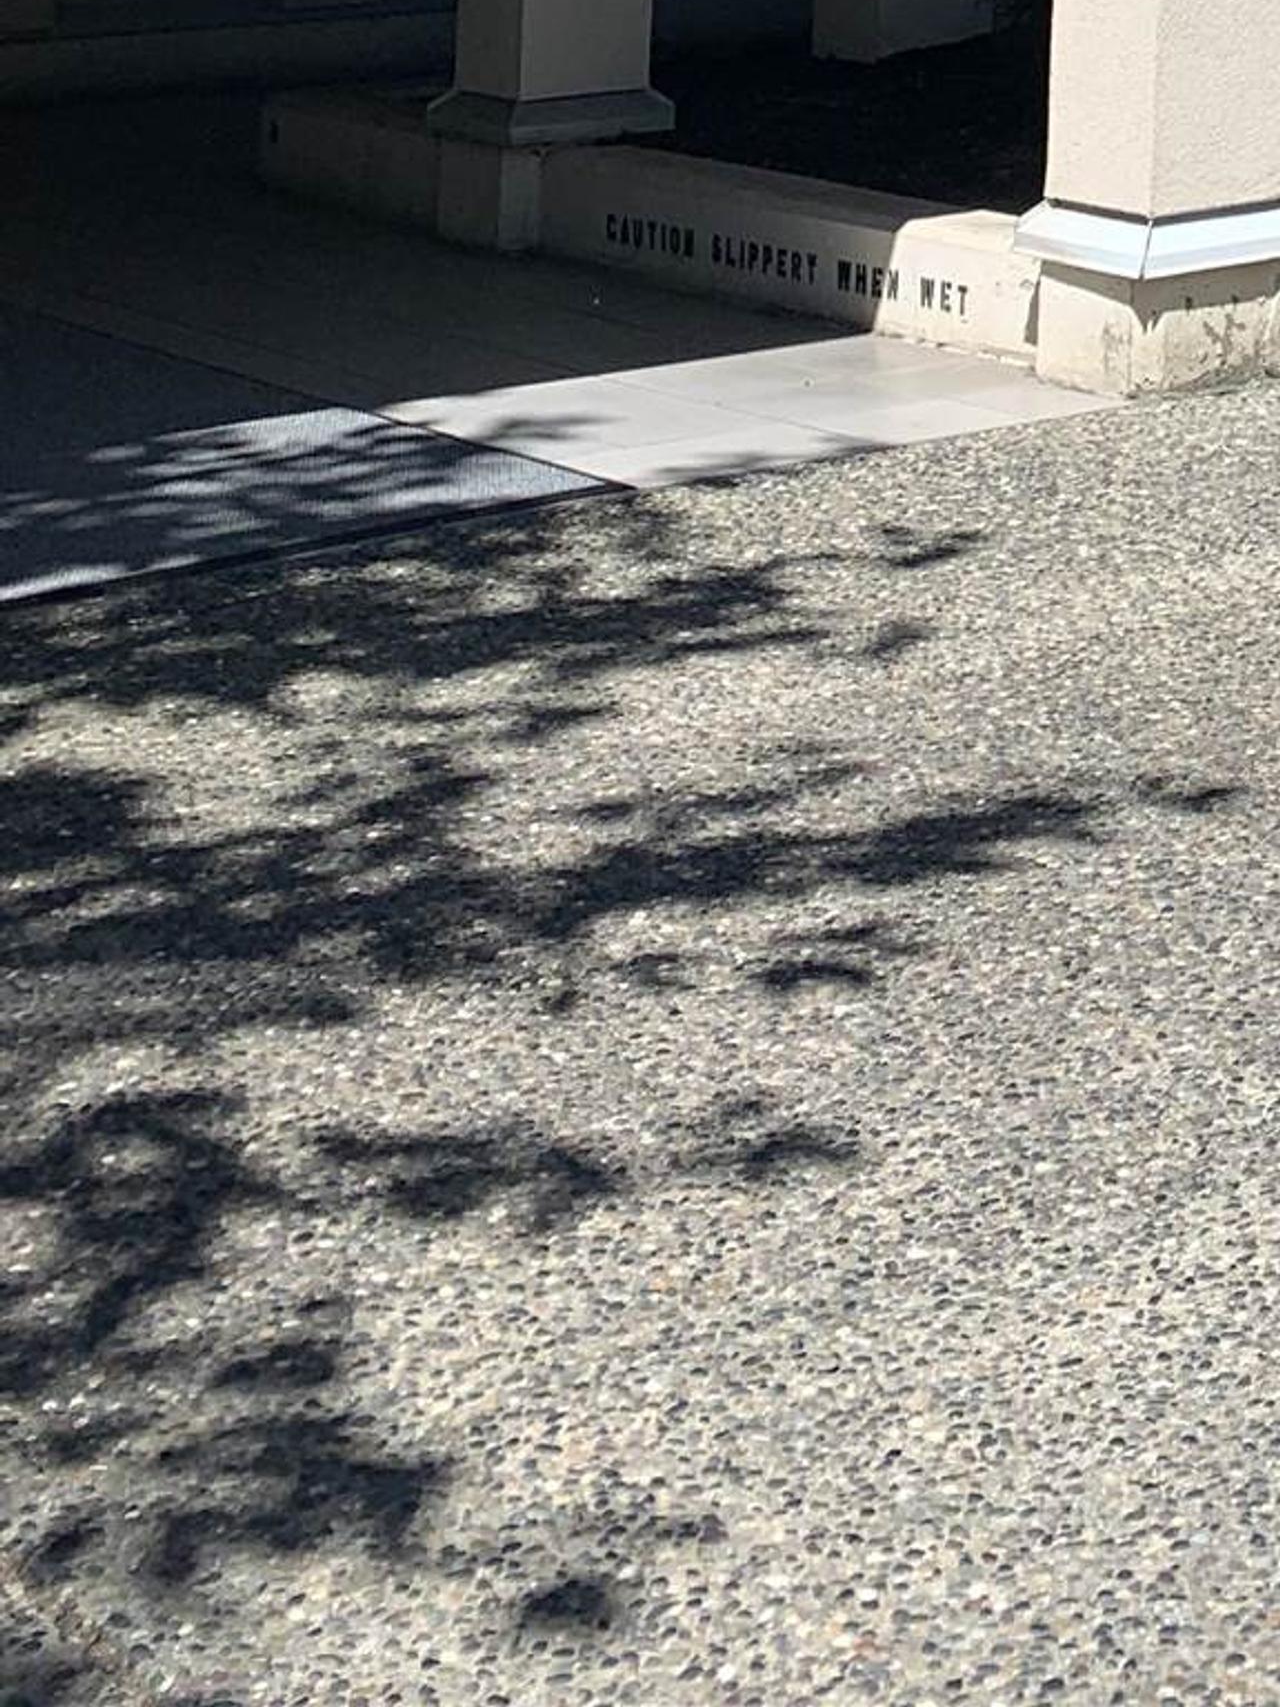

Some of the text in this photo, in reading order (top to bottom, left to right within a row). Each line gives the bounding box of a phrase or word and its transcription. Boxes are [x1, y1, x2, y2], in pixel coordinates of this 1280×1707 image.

[606, 213, 969, 317] CAUTION SLIPPERY WHEN WET
